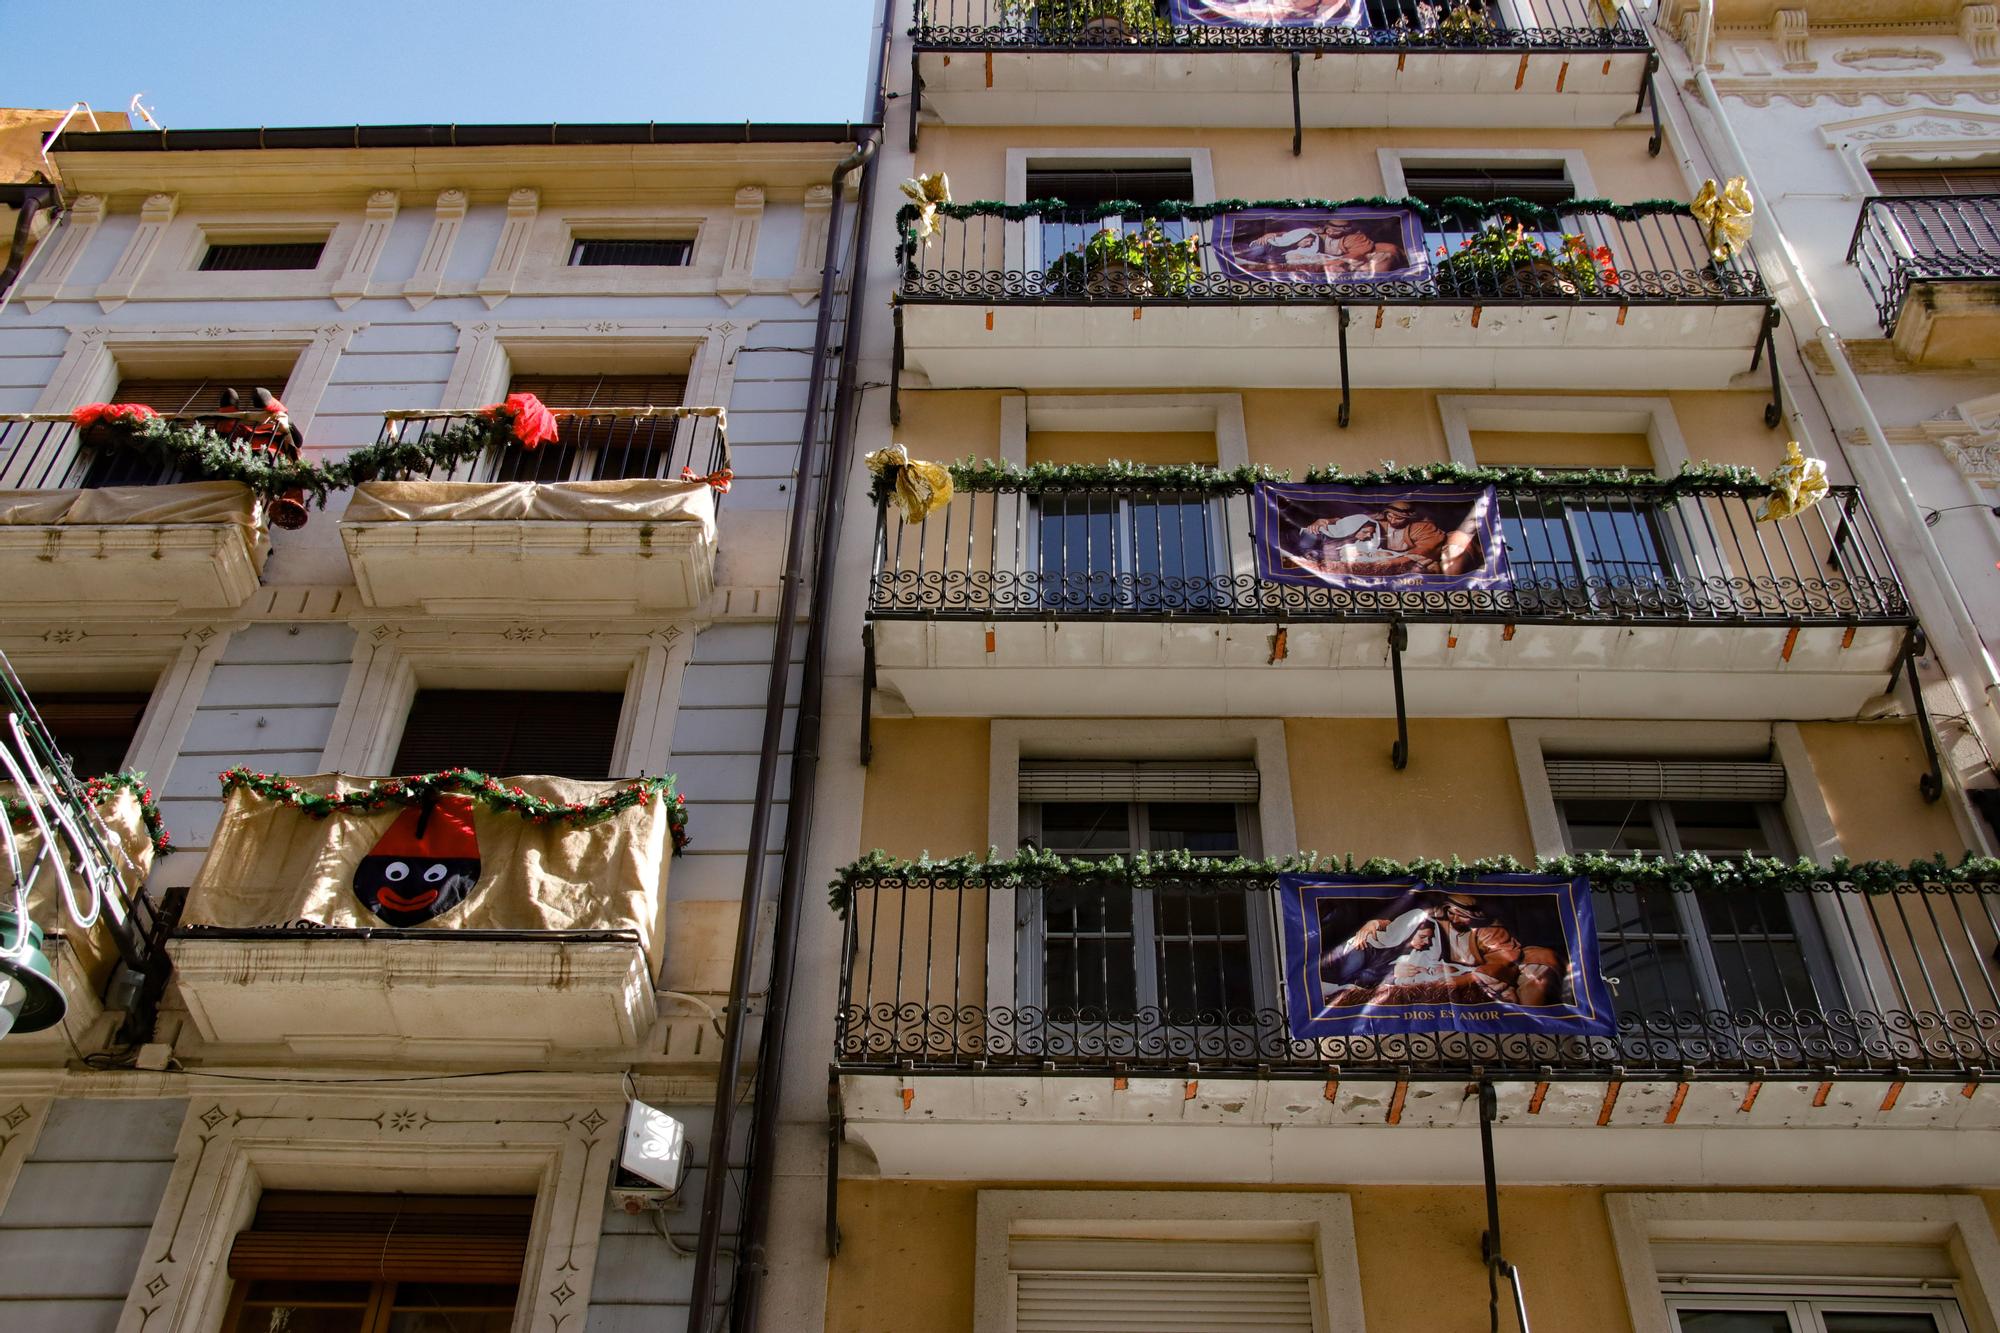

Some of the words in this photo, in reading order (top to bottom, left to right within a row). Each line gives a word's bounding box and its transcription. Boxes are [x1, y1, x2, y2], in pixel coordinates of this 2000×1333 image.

[1403, 1010, 1435, 1020] DIOS
[1440, 1009, 1455, 1018] ES
[1459, 1010, 1500, 1020] AMOR
